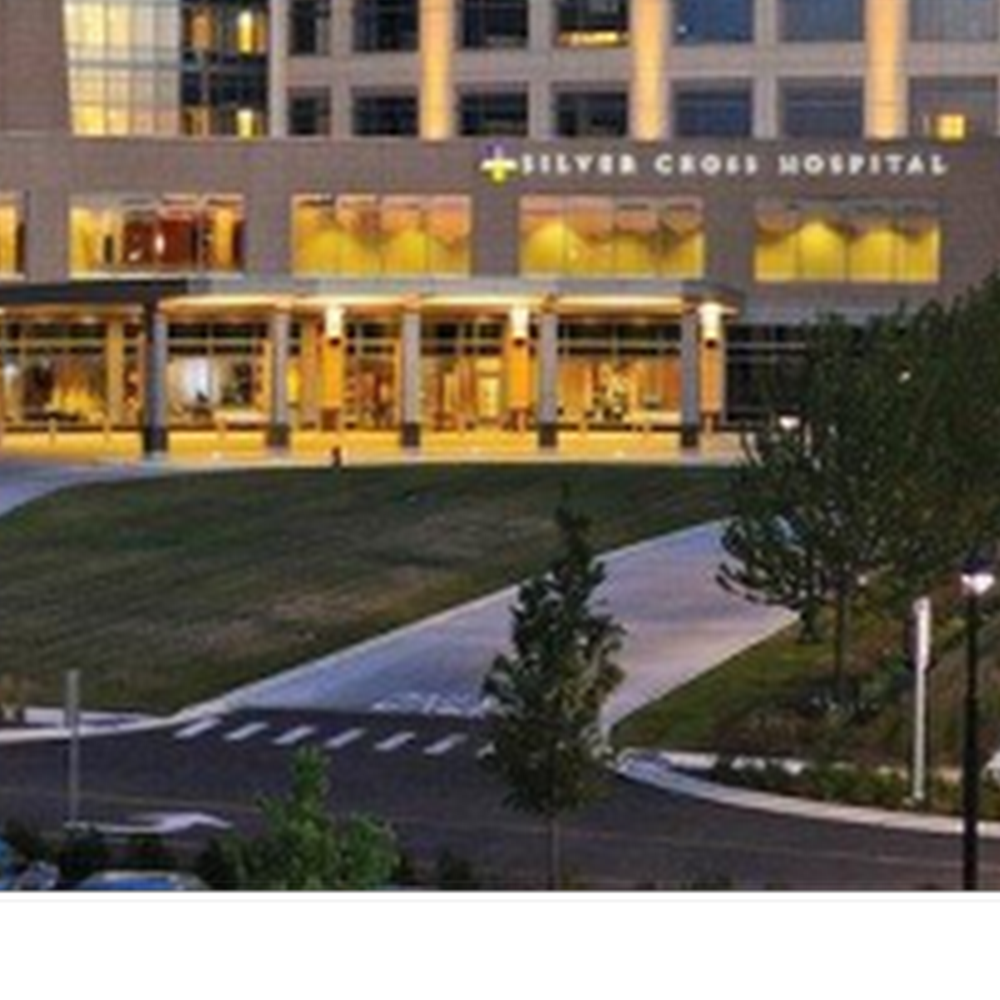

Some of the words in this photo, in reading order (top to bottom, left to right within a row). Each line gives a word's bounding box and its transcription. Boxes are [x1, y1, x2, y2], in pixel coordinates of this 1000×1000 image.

[522, 153, 637, 175] SILVER
[654, 153, 758, 176] CROSS
[778, 153, 947, 175] HOSPITAL
